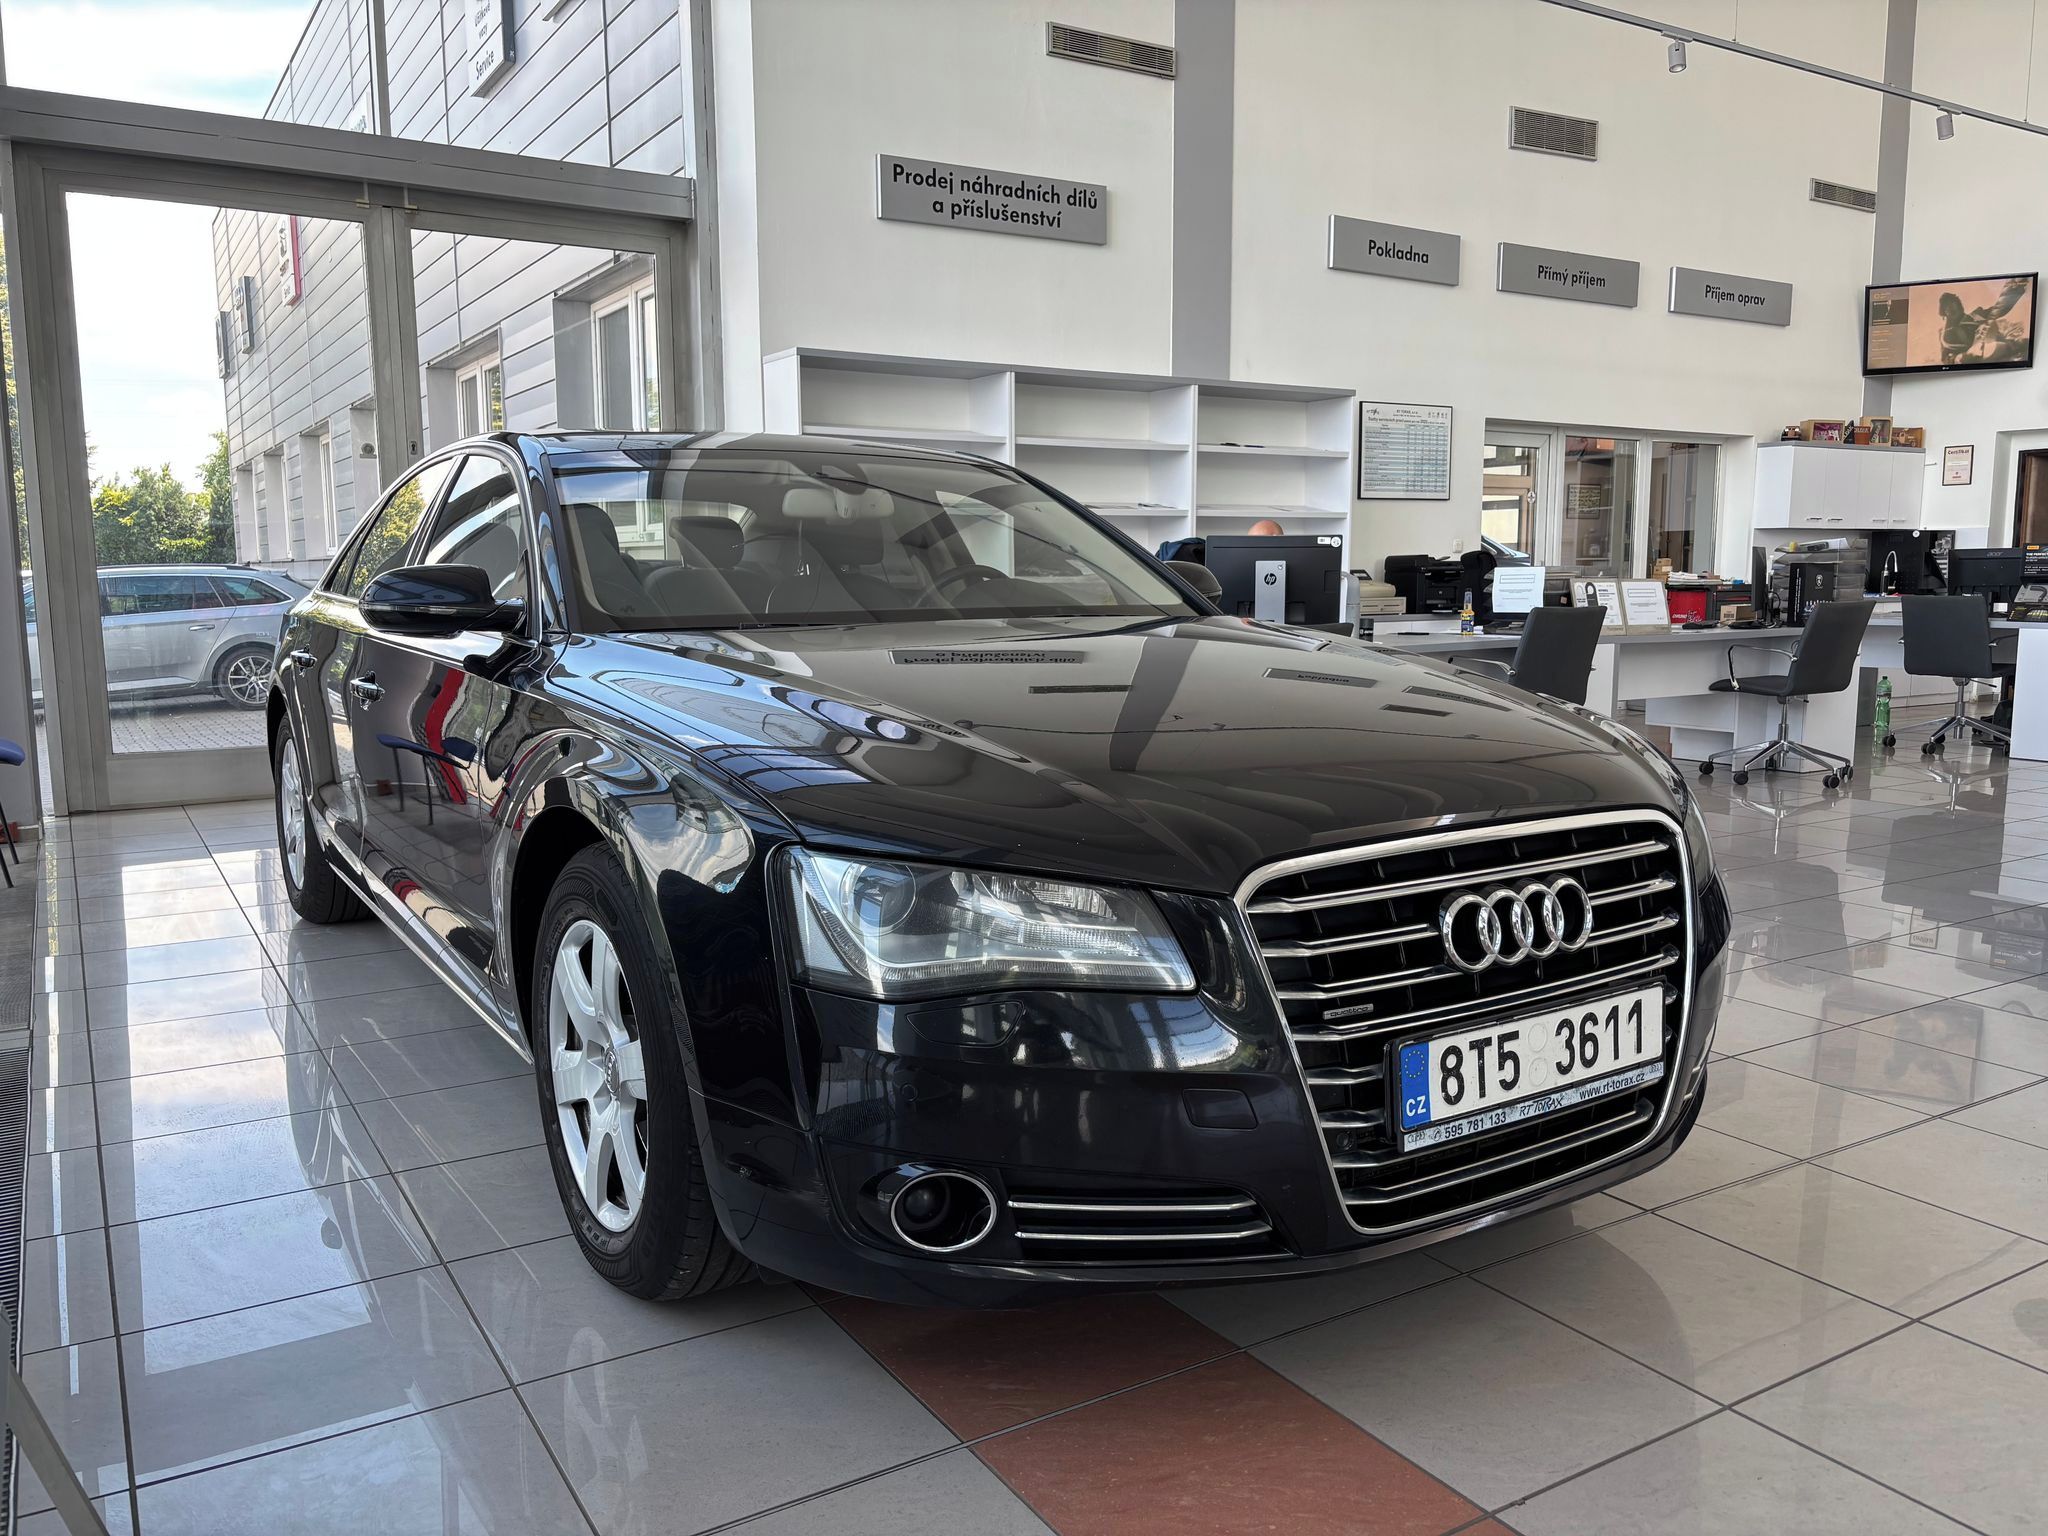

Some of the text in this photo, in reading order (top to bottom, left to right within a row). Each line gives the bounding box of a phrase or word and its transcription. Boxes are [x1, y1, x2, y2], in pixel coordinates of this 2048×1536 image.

[475, 50, 495, 80] Service
[892, 163, 1098, 210] Prodej náhradních dílů
[932, 199, 1062, 229] a příslušenství
[1368, 239, 1429, 264] Pokladna
[1537, 264, 1606, 289] Přímý příjem
[1704, 284, 1766, 307] Příjem oprav
[1264, 573, 1277, 585] hp
[1329, 1006, 1369, 1017] quattro
[1440, 998, 1643, 1106] 8T5 3611
[1406, 1095, 1427, 1117] CZ
[1444, 1073, 1645, 1139] 595 781 133 RT TORAX www.rt-torax.cz
